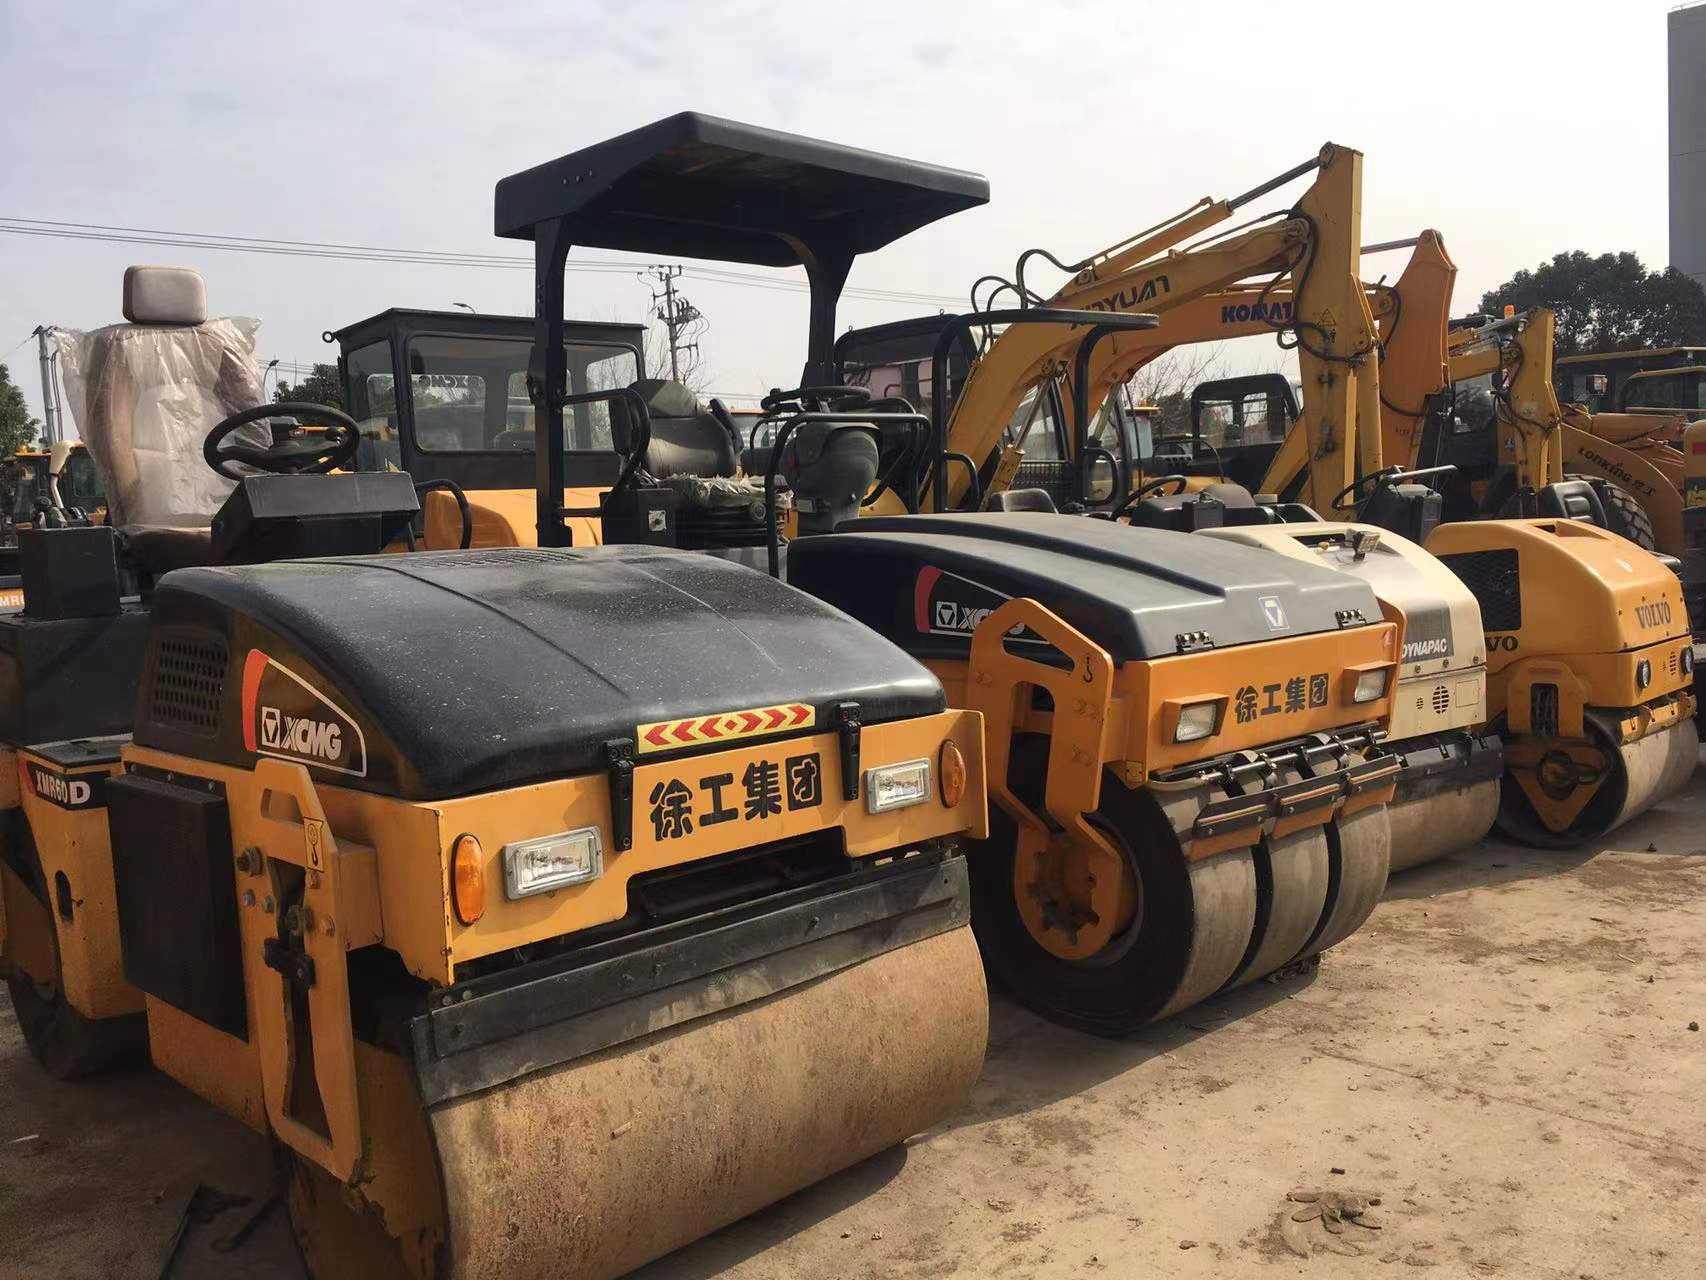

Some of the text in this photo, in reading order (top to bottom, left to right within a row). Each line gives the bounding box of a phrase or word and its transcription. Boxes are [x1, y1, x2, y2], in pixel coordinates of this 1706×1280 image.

[1635, 601, 1671, 629] VOLVO
[1235, 673, 1329, 724] 徐工集团
[280, 716, 342, 761] XCMG
[650, 752, 822, 842] 徐工集团
